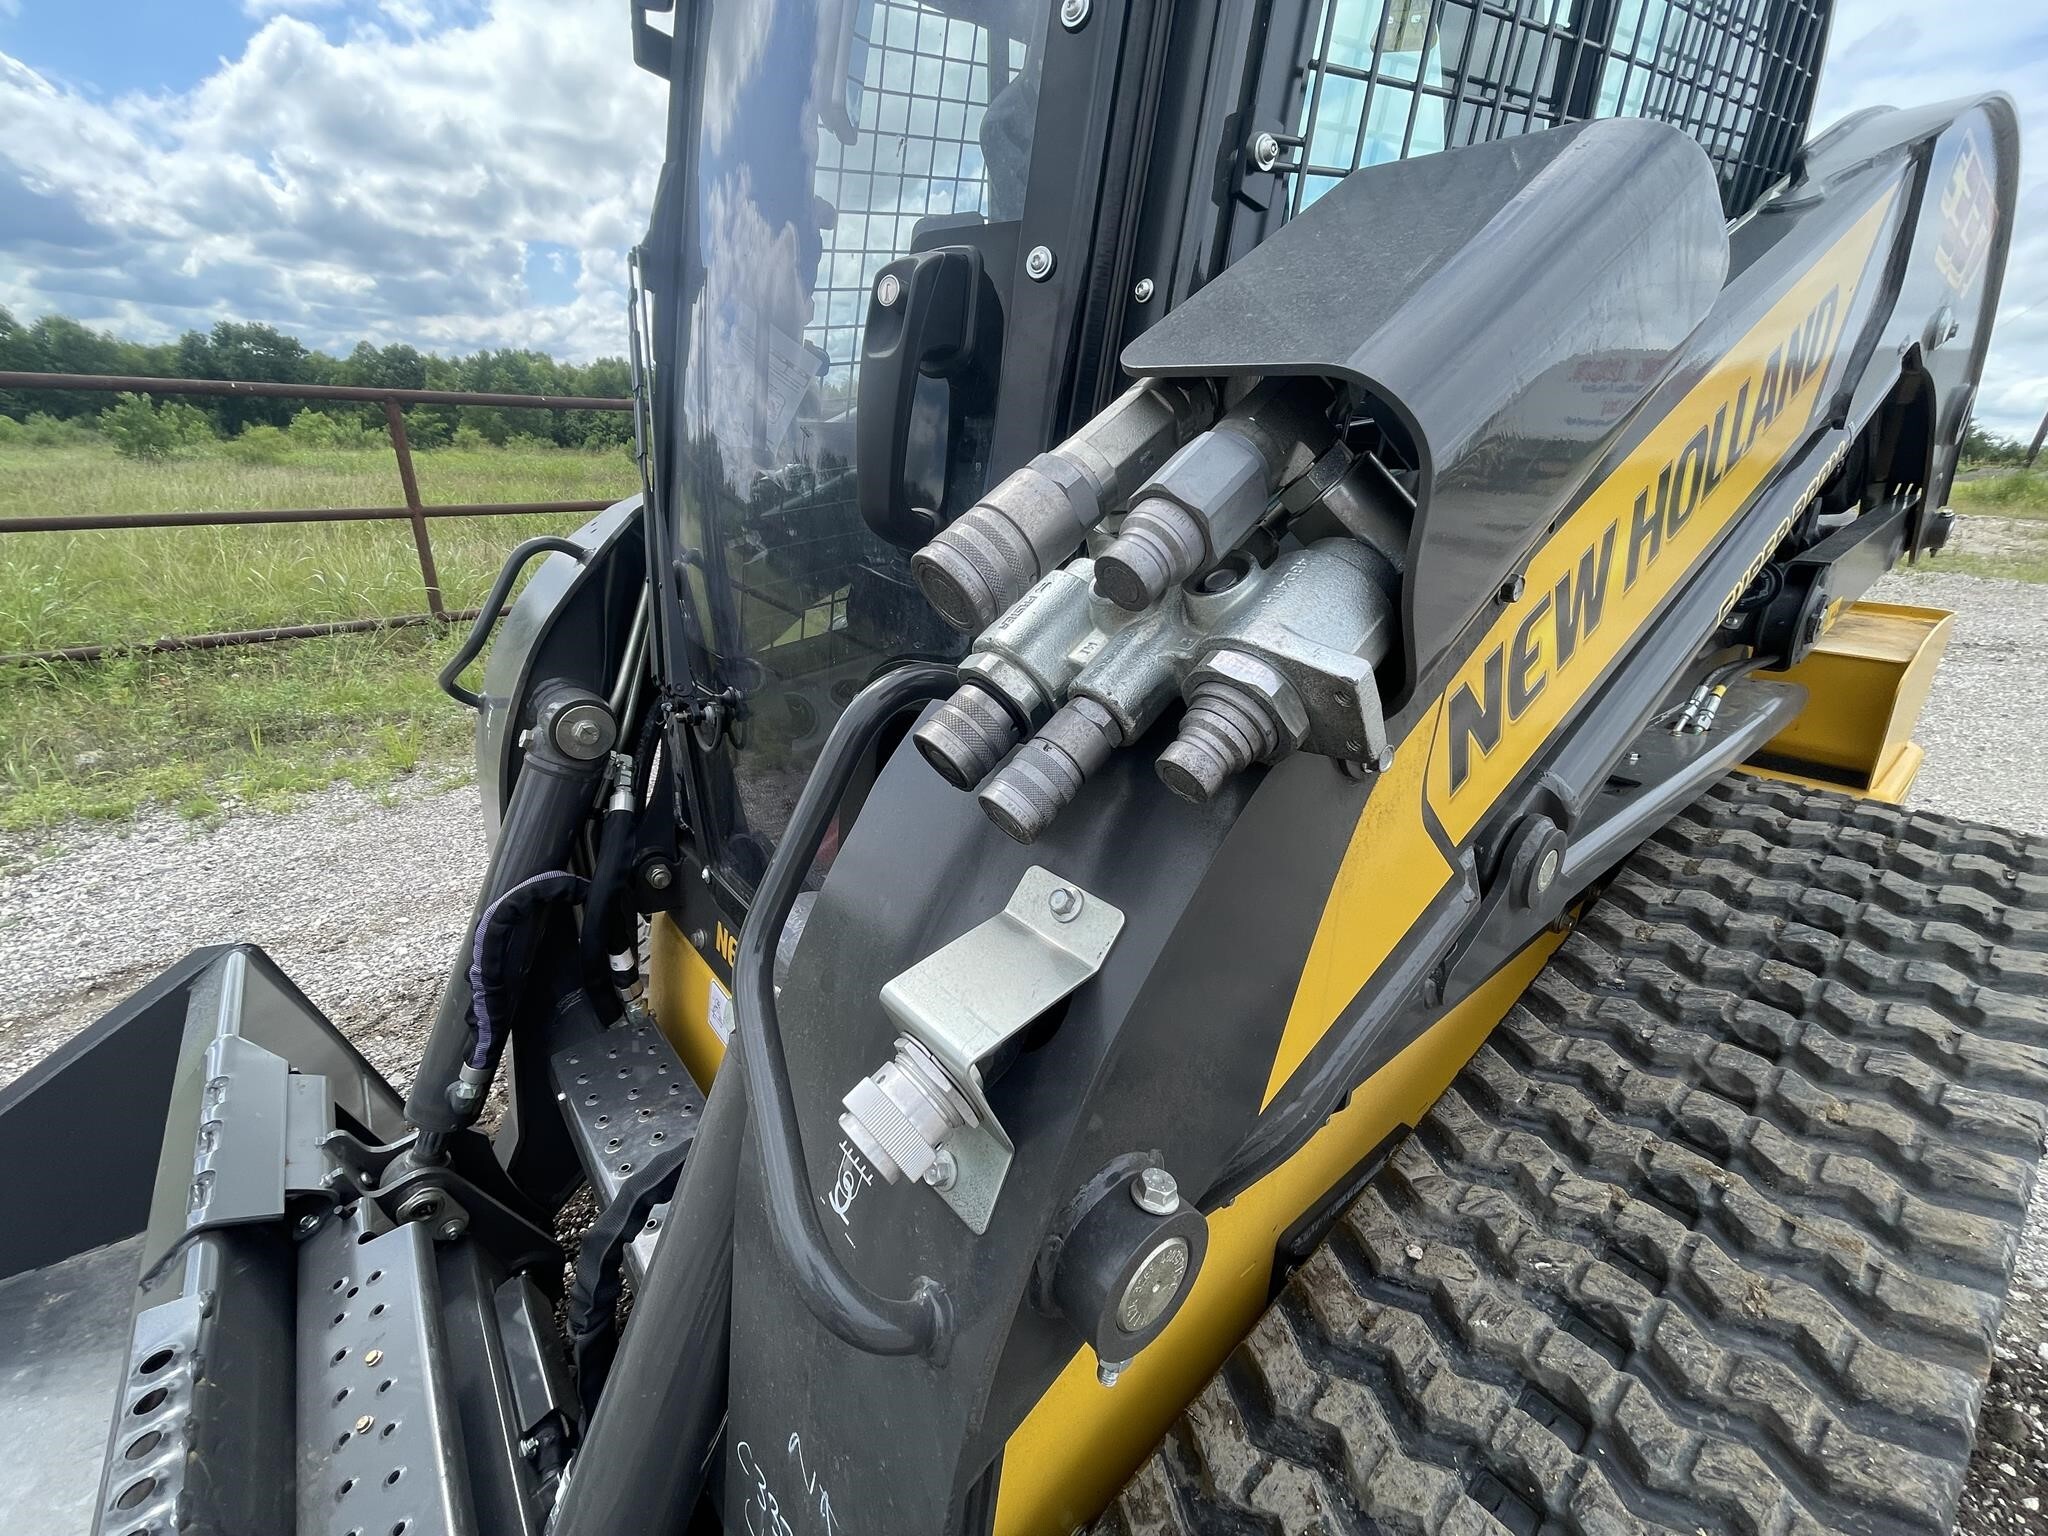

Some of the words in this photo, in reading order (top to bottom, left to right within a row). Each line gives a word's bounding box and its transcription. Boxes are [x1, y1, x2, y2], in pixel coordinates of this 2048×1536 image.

[1449, 517, 1618, 797] NEW
[1622, 283, 1840, 594] HOLLAND
[715, 920, 738, 968] NE
